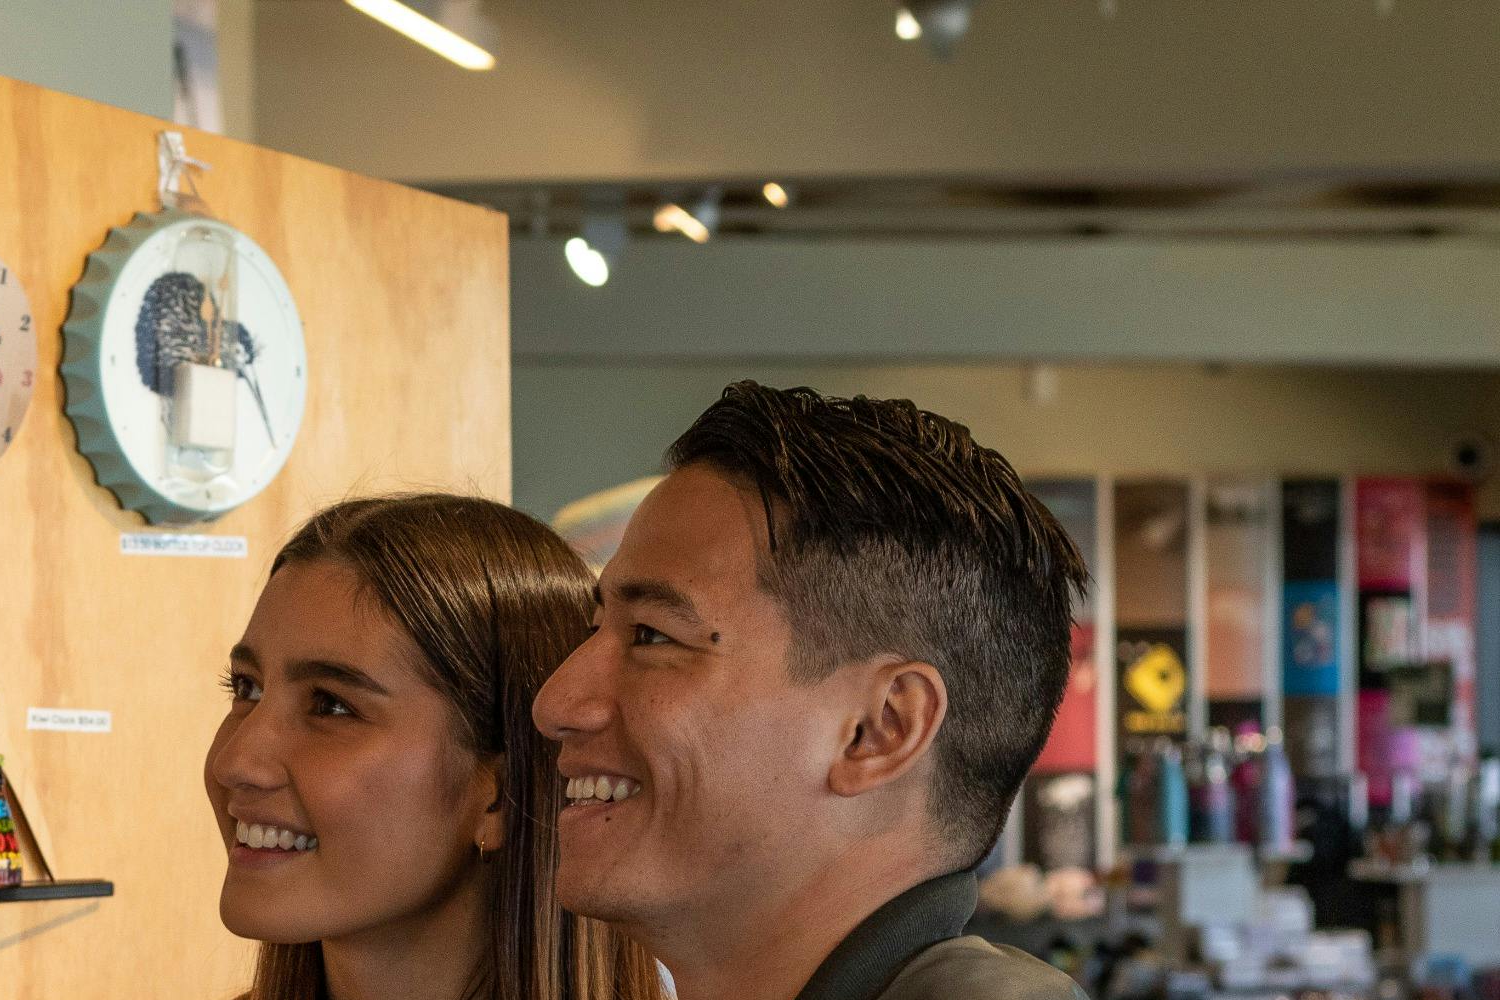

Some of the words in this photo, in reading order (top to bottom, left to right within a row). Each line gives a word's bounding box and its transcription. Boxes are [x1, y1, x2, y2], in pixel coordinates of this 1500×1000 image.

[0, 268, 7, 286] 1
[20, 315, 30, 332] 2
[22, 370, 33, 387] 3
[2, 427, 12, 443] 4
